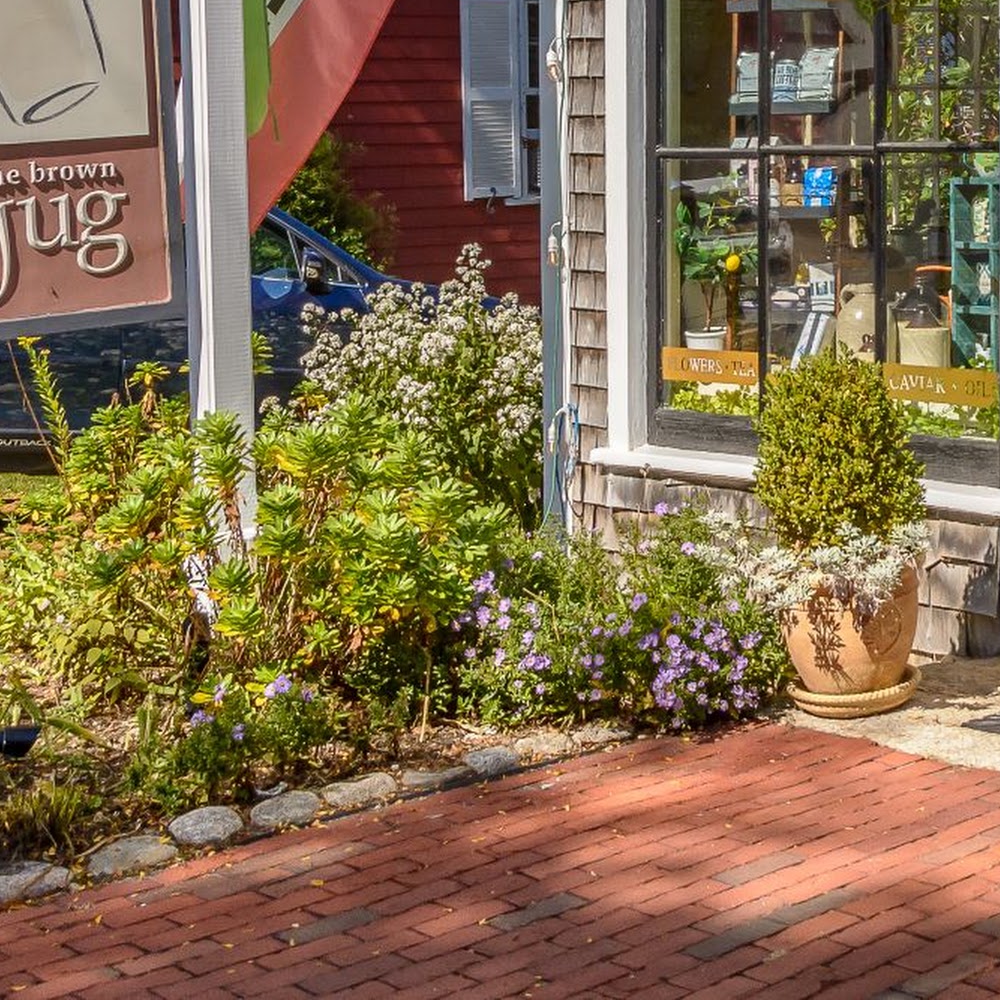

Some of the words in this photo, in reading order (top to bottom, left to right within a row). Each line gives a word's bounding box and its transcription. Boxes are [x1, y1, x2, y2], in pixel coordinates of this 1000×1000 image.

[28, 160, 117, 184] brown
[674, 356, 723, 375] OWERS
[730, 360, 756, 377] TEA
